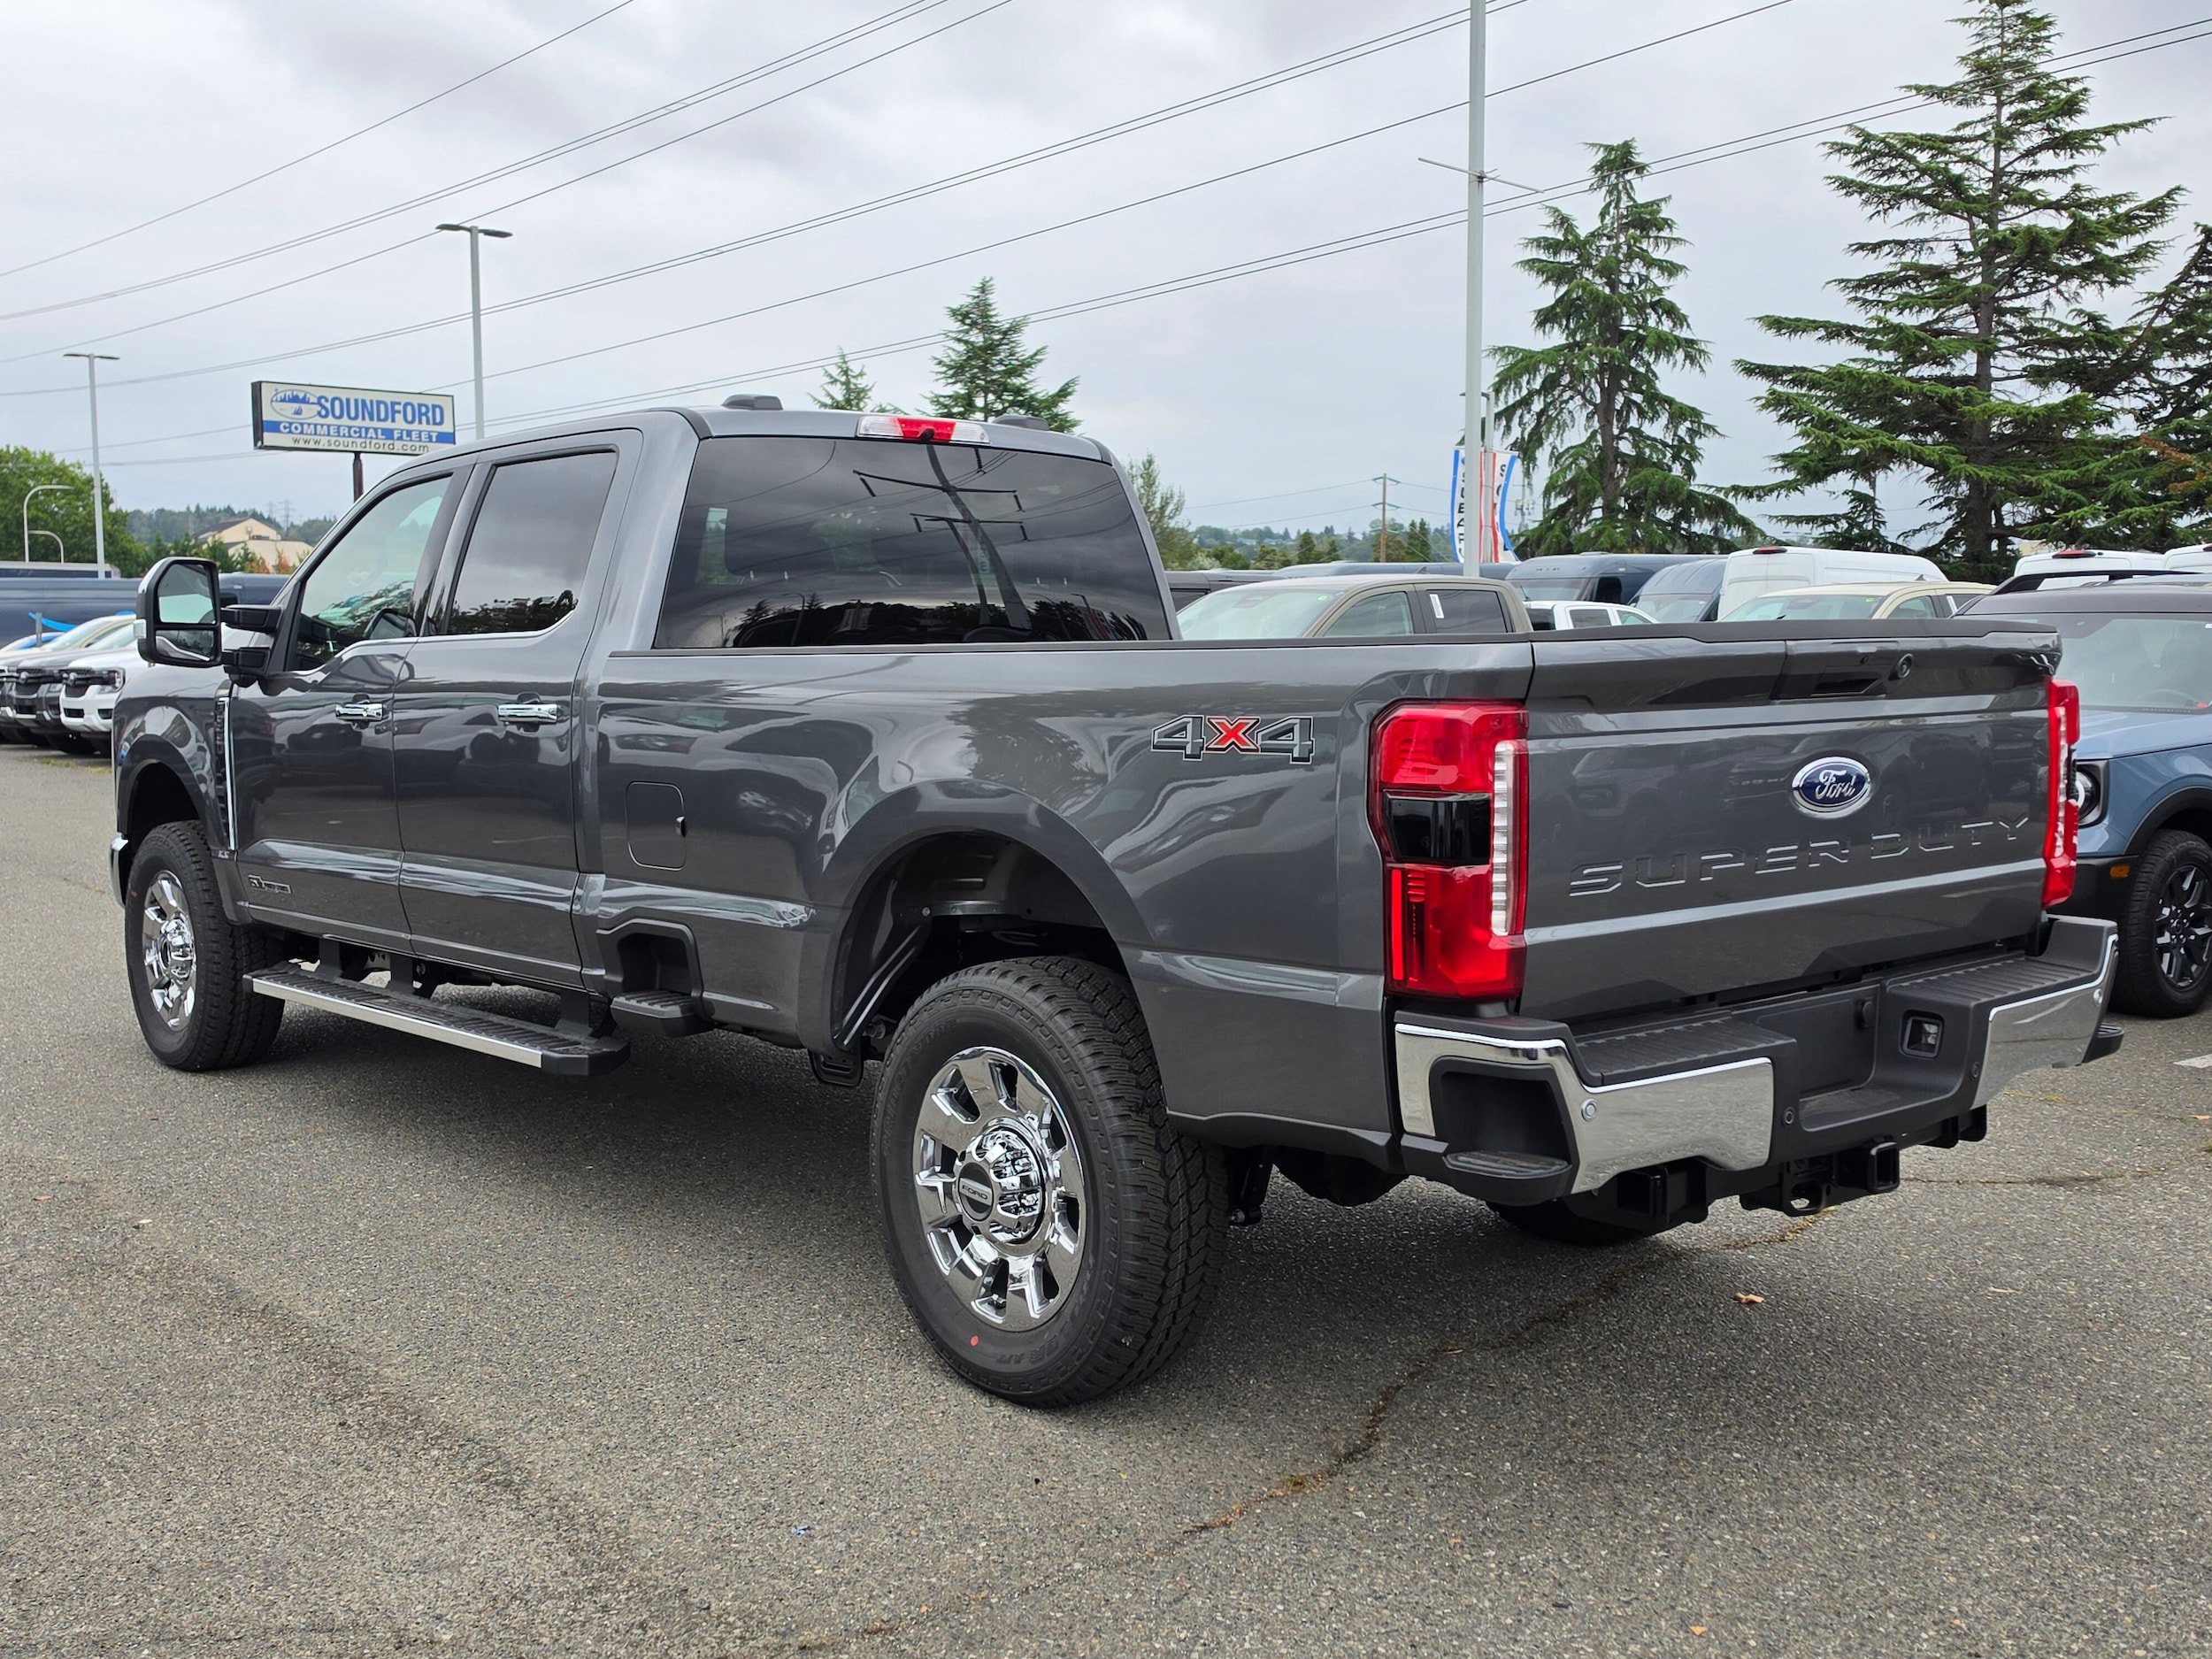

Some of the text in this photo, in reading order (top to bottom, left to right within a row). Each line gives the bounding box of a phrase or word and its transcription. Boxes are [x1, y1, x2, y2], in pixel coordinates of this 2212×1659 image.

[317, 395, 445, 426] SOUNDFORD
[279, 421, 439, 442] COMMERCIAL FLEET
[290, 436, 430, 454] www.soundford.com
[1815, 769, 1857, 800] Ford
[1569, 815, 2030, 897] SUPER DUTY
[961, 1184, 989, 1201] FORD
